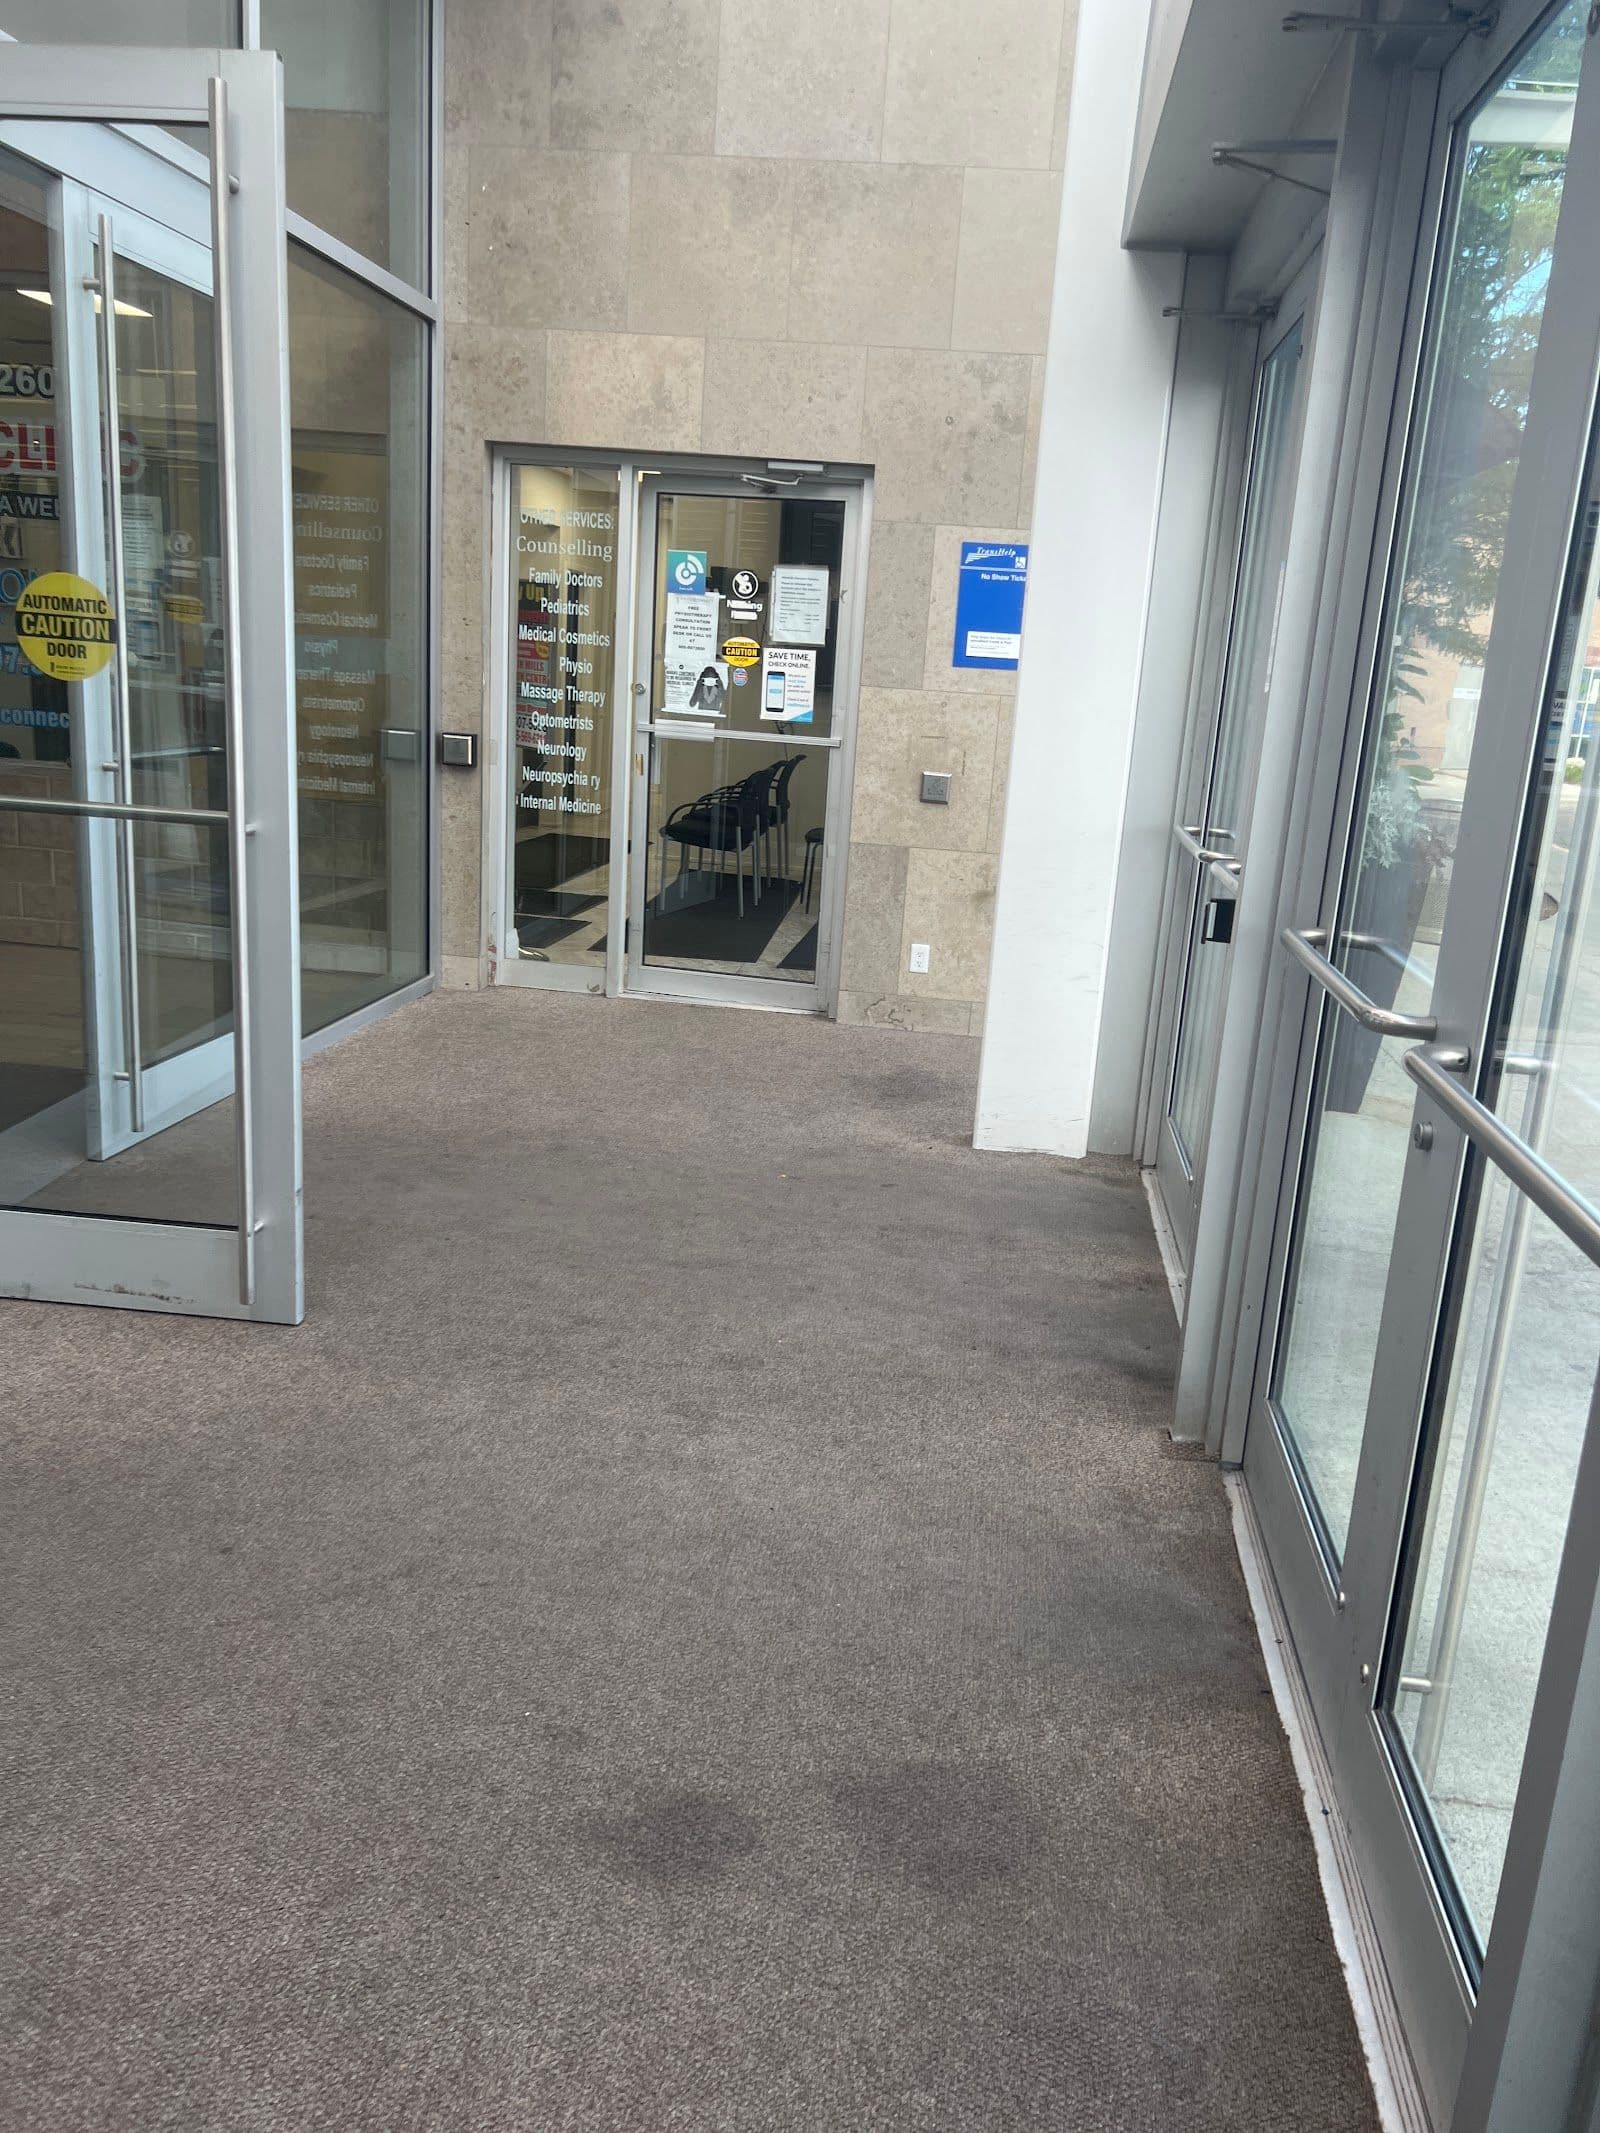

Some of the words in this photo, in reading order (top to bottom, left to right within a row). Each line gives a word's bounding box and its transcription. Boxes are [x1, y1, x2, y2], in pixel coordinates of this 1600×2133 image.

[516, 535, 613, 562] Counselling
[977, 547, 1017, 558] TransHelp
[528, 567, 562, 589] Family
[564, 569, 603, 588] Doctors
[23, 593, 107, 615] AUTOMATIC
[540, 597, 590, 617] Pediatrics
[22, 613, 110, 642] CAUTION
[518, 624, 557, 643] Medical
[558, 627, 611, 647] Cosmetics
[47, 641, 87, 659] DOOR
[725, 647, 758, 657] CAUTION
[768, 651, 788, 660] SAVE
[559, 656, 593, 677] Physio
[521, 681, 564, 704] Massage
[565, 685, 606, 708] Therapy
[531, 711, 594, 732] Optometrists
[537, 739, 587, 762] Neurology
[522, 766, 589, 788] Neuropsychia
[590, 774, 600, 791] ry
[520, 793, 557, 812] Internal
[558, 795, 602, 815] Medicine
